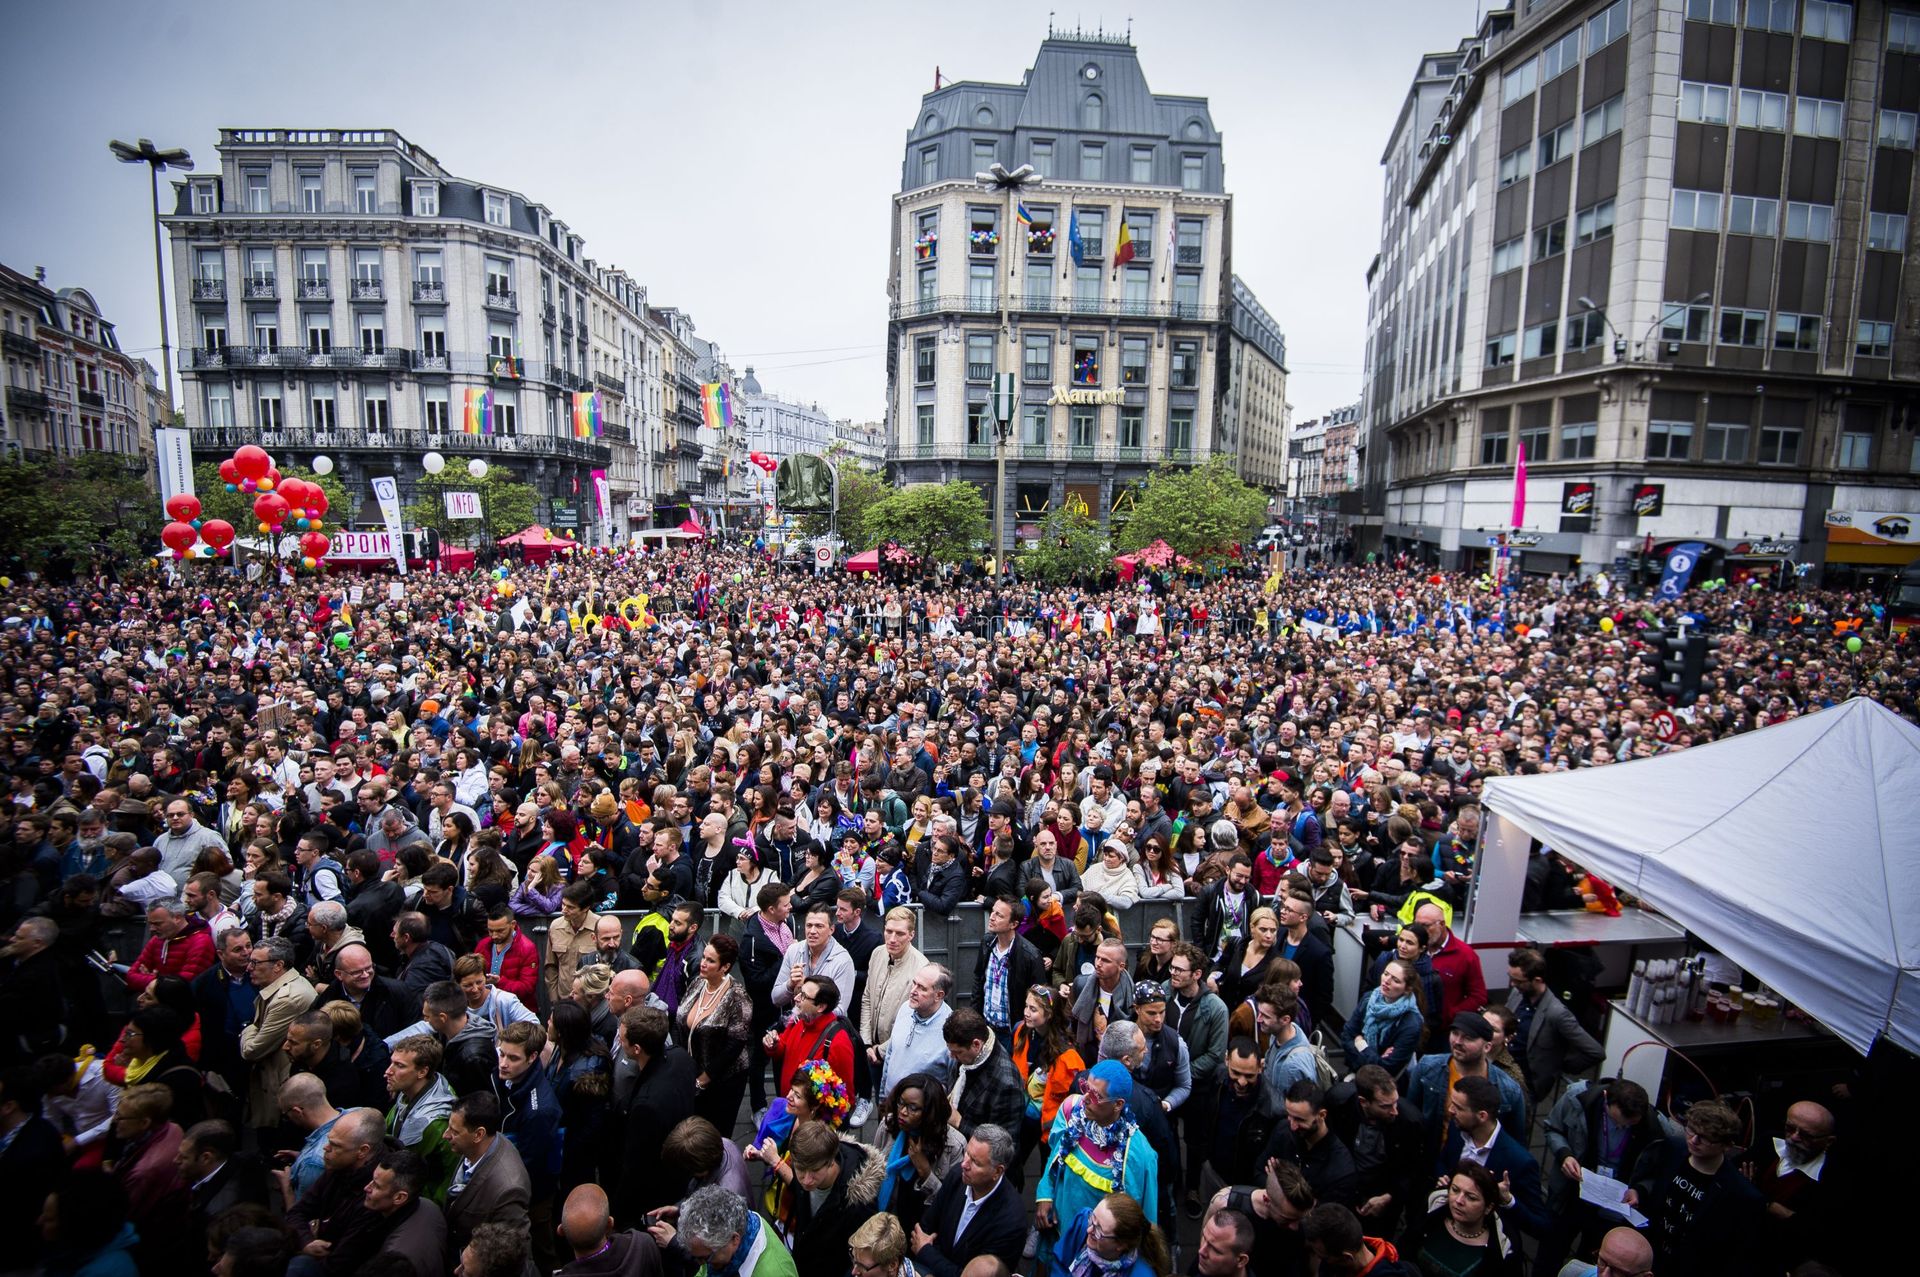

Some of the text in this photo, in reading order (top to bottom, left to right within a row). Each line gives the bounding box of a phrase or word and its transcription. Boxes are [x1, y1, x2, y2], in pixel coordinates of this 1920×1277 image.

[1046, 384, 1126, 406] Marriott
[451, 494, 474, 514] INFO
[1749, 543, 1795, 554] Pizza Hut
